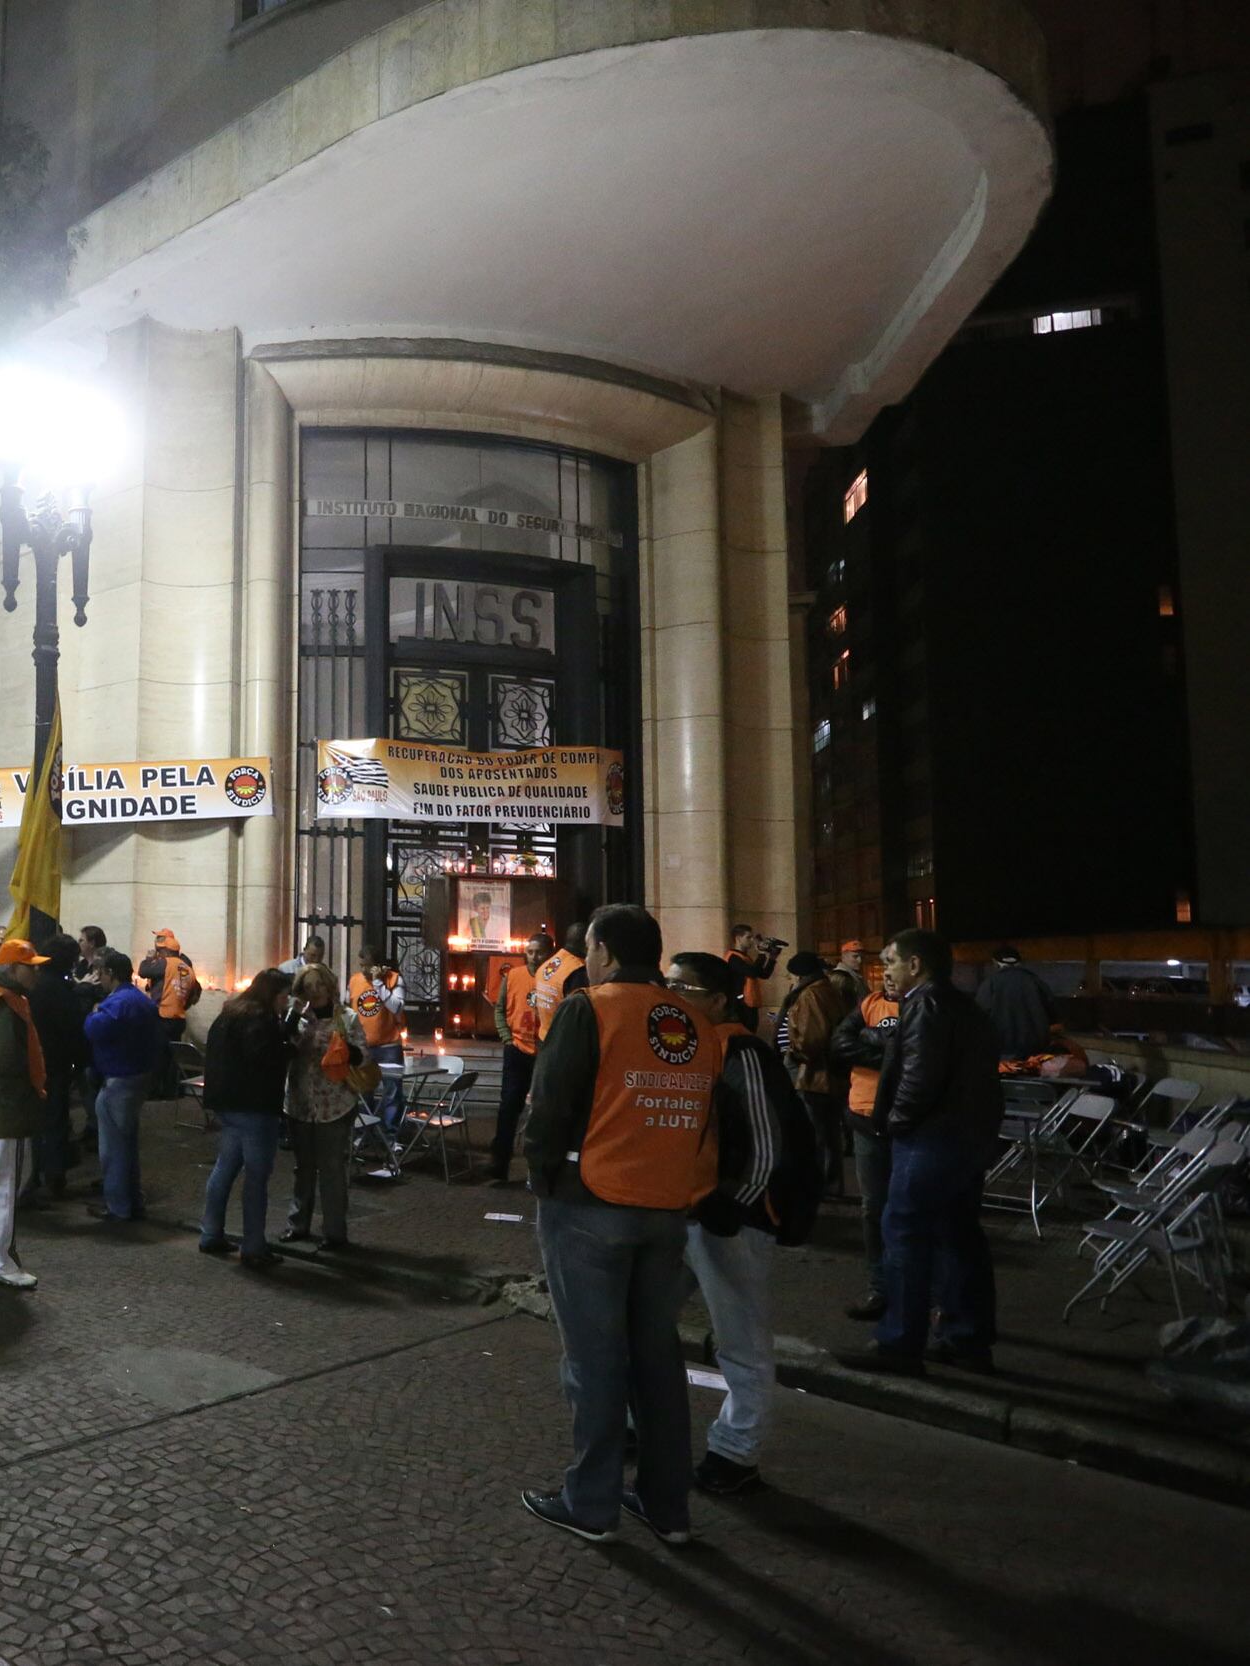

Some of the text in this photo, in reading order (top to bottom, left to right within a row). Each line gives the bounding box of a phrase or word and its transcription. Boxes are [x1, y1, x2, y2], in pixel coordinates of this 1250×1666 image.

[317, 501, 397, 516] INSTITUTO
[488, 510, 508, 525] DO
[416, 582, 542, 649] INSS
[499, 753, 537, 766] PODER
[542, 752, 555, 764] DE
[142, 766, 215, 788] PELA
[229, 767, 259, 780] FORÇA
[440, 767, 558, 780] DOS APOSENTADOS
[226, 787, 266, 807] SINDICAL
[453, 783, 506, 799] PÚBLICA
[508, 785, 522, 797] DE
[524, 785, 588, 799] QUALIDADE
[63, 795, 197, 819] GNIDADE
[413, 802, 591, 819] FIM DO FATOR PREVIDENCIÁRIO
[650, 1036, 698, 1063] SINDICAL
[645, 1114, 698, 1129] a LUTA
